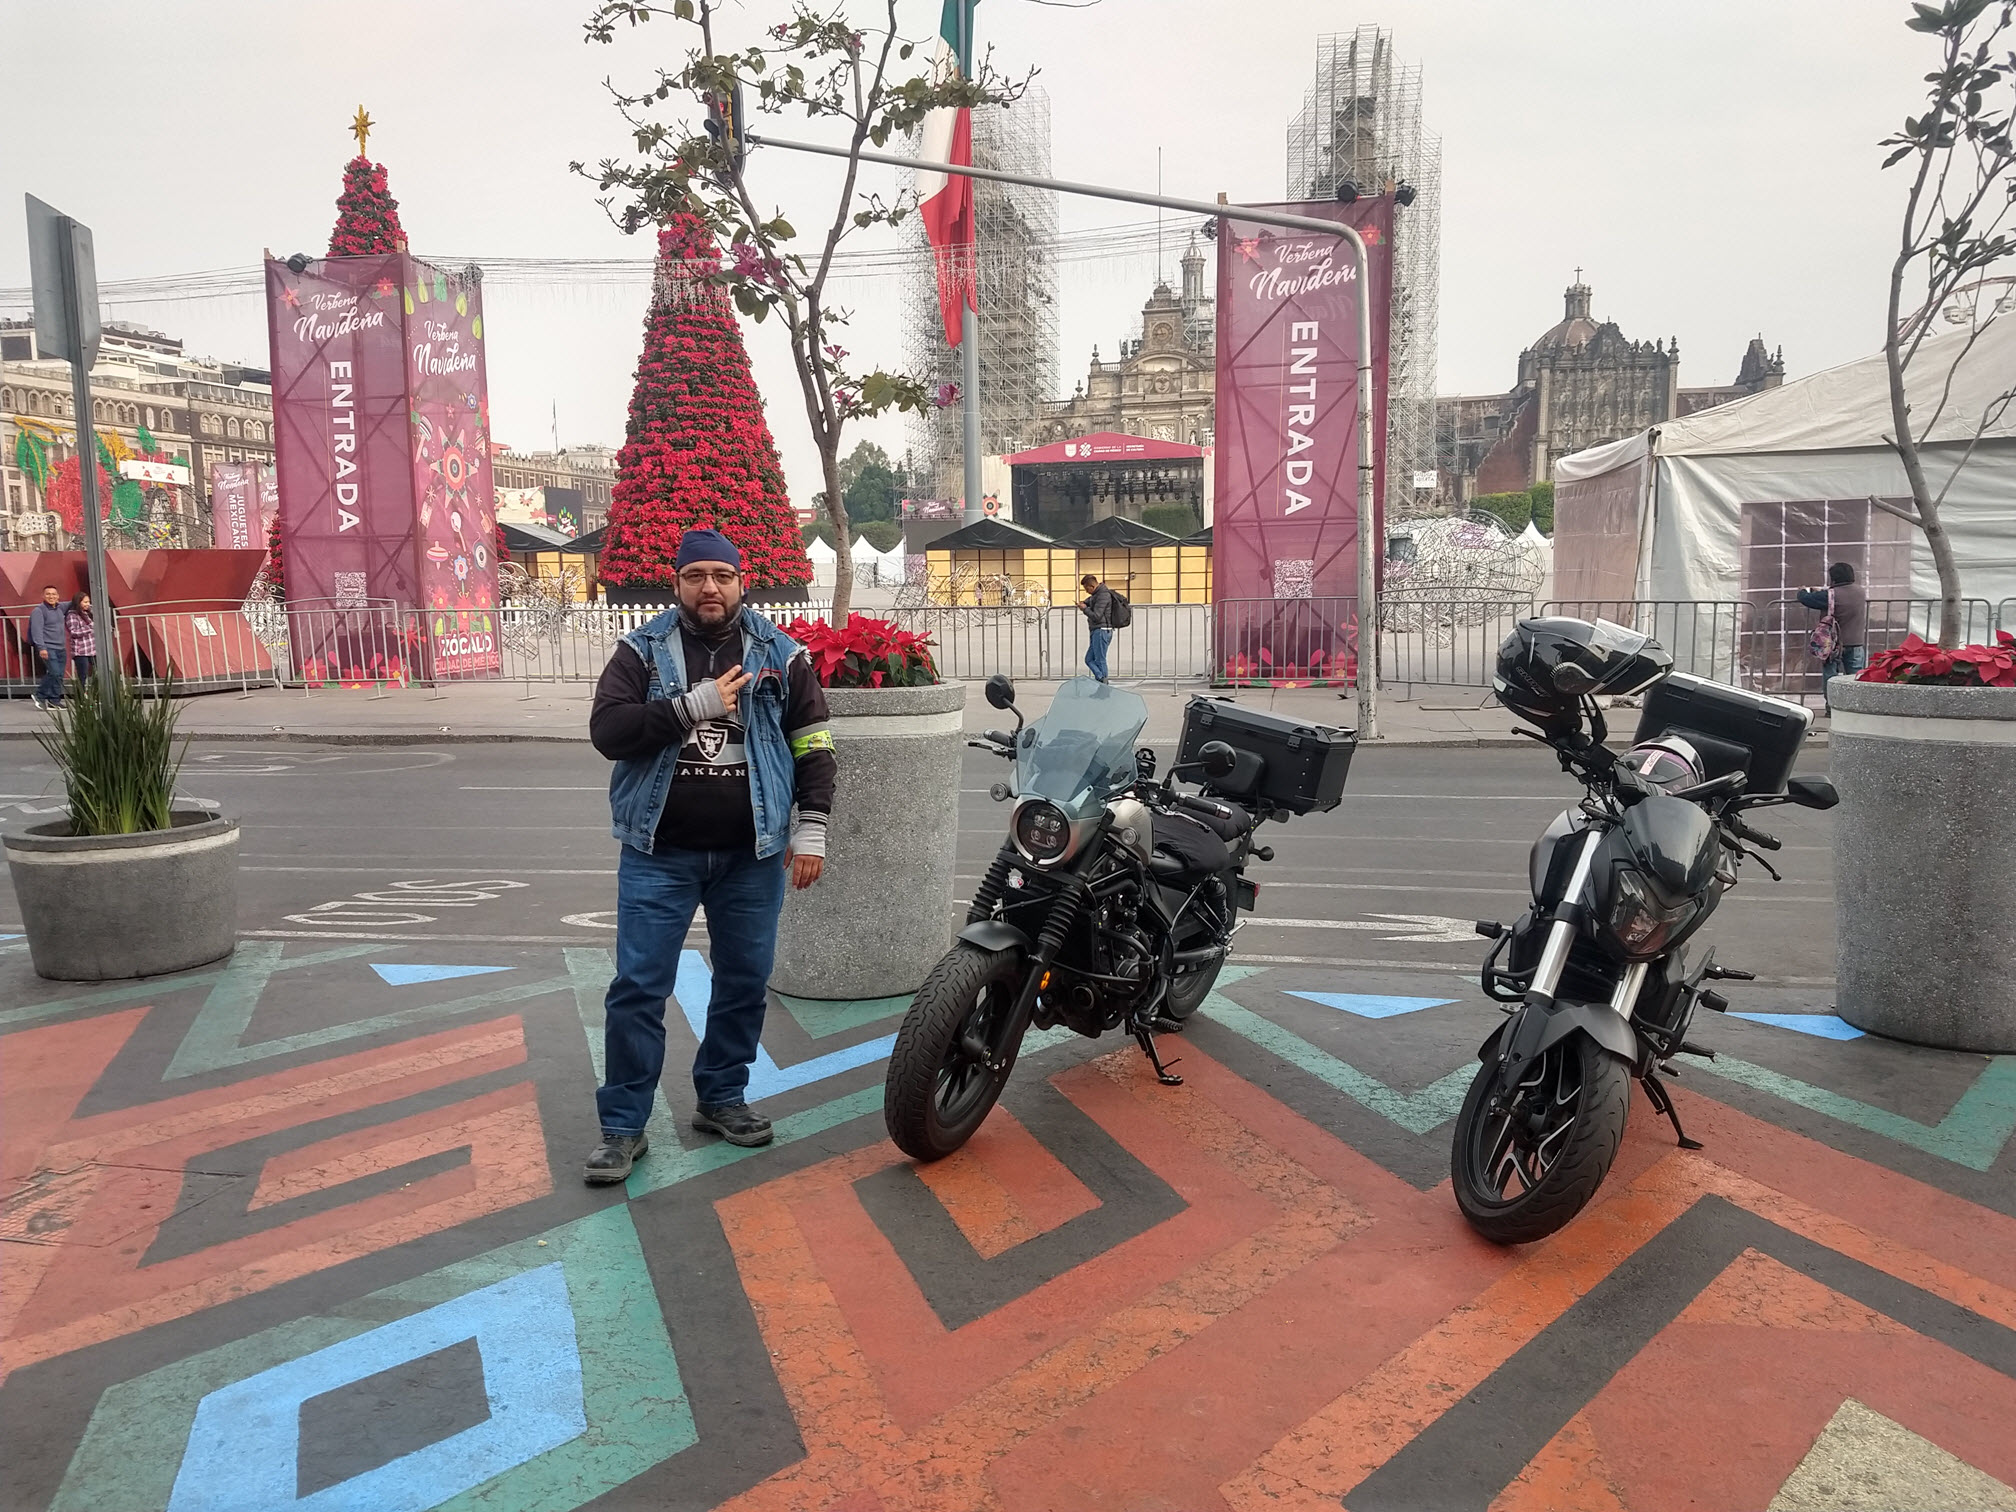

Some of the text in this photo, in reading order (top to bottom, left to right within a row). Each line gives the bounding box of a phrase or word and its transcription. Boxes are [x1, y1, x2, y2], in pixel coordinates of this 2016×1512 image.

[1275, 241, 1334, 264] Verbena
[310, 291, 358, 311] Verbena
[293, 307, 384, 342] Navideña
[424, 320, 459, 341] Verbena
[413, 342, 477, 376] Navideña
[1284, 320, 1319, 516] ENTRADA
[330, 360, 360, 533] ENTRADA
[236, 493, 249, 547] JUGUETES
[441, 634, 493, 657] ZÓCALO
